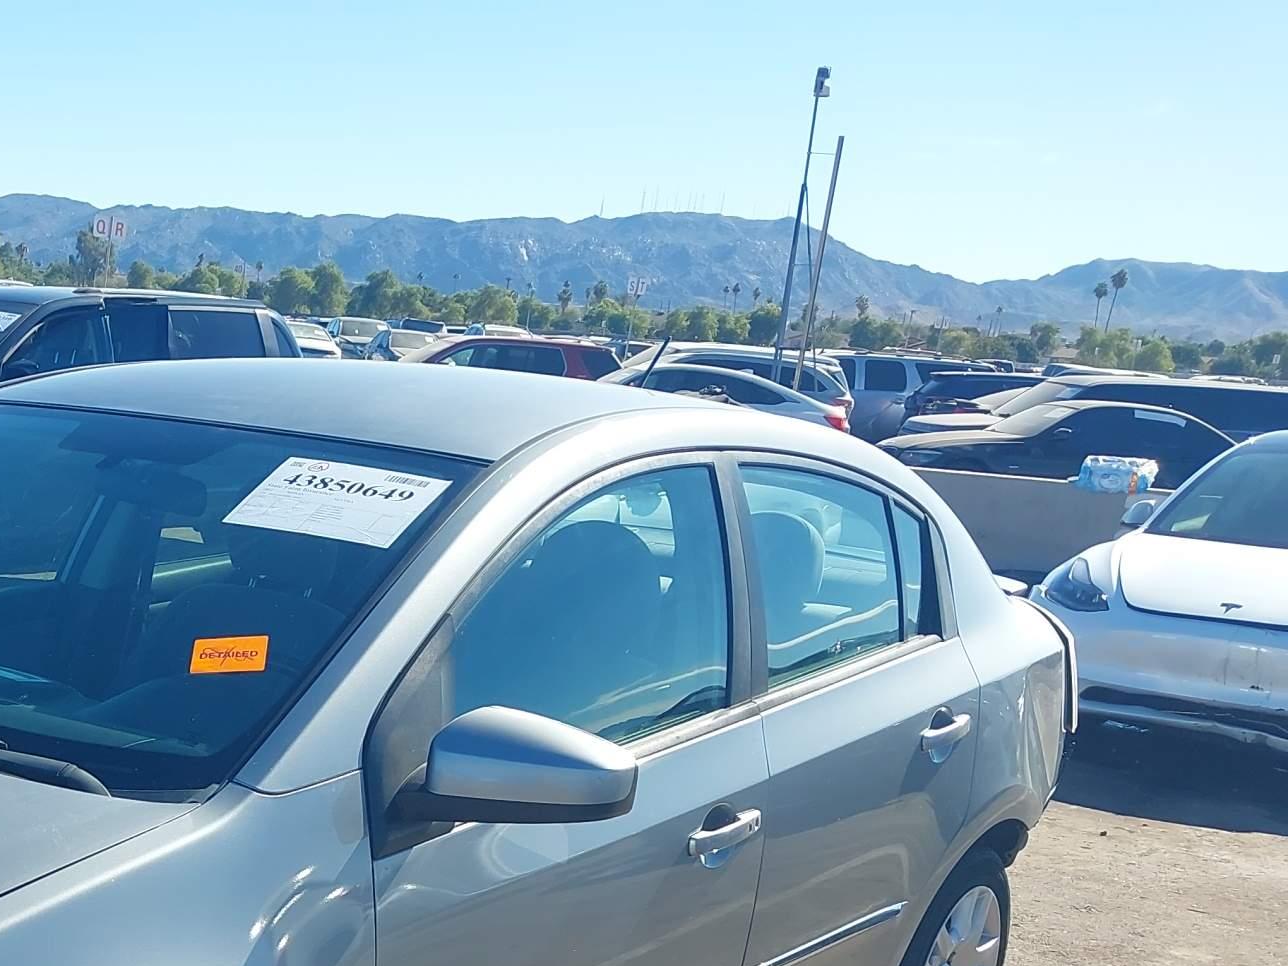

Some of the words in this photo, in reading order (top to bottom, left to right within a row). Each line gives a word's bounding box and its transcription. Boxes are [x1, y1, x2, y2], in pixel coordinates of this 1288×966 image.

[96, 219, 106, 234] Q
[115, 222, 124, 237] R
[629, 280, 635, 292] S
[640, 281, 646, 292] T
[282, 473, 415, 502] 43850649
[199, 649, 258, 660] DETAILED
